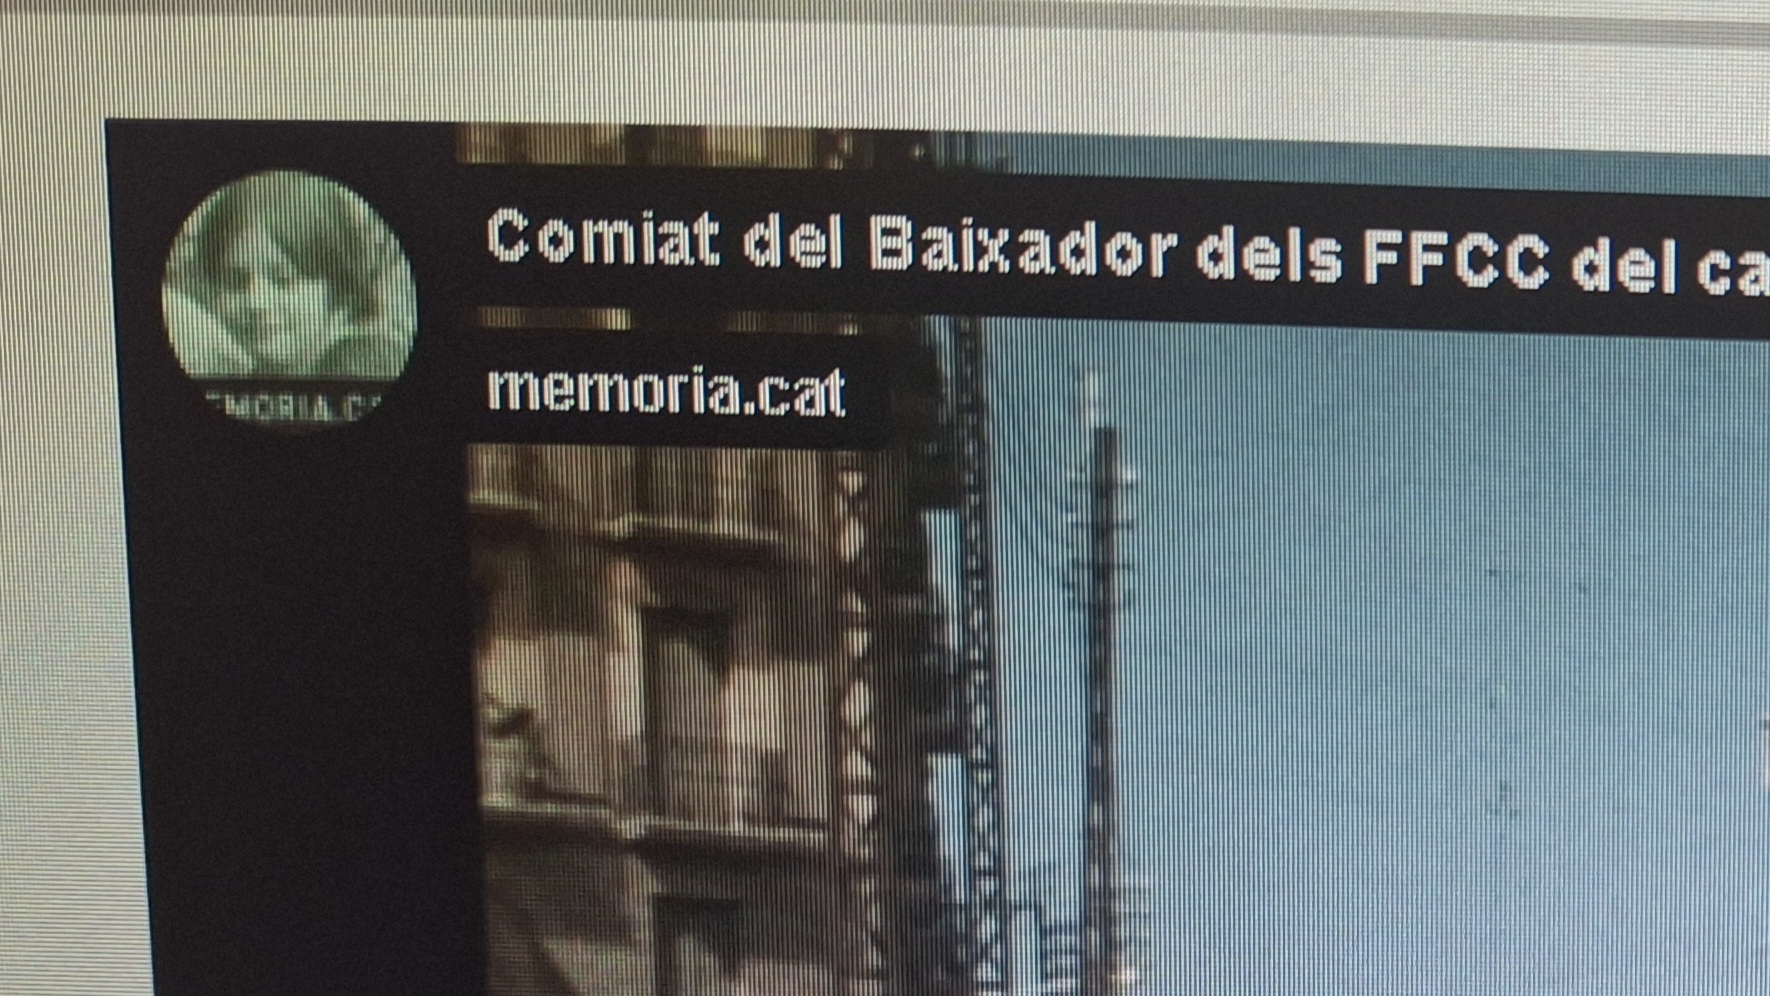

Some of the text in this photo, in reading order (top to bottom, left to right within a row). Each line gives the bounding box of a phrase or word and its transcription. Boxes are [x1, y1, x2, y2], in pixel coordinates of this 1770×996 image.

[488, 209, 720, 265] Comiat
[744, 213, 841, 268] del
[870, 216, 1178, 277] Baixador
[1197, 225, 1341, 282] dels
[1365, 230, 1549, 289] FFCC
[1573, 237, 1675, 293] del
[489, 366, 845, 416] memoria.cat
